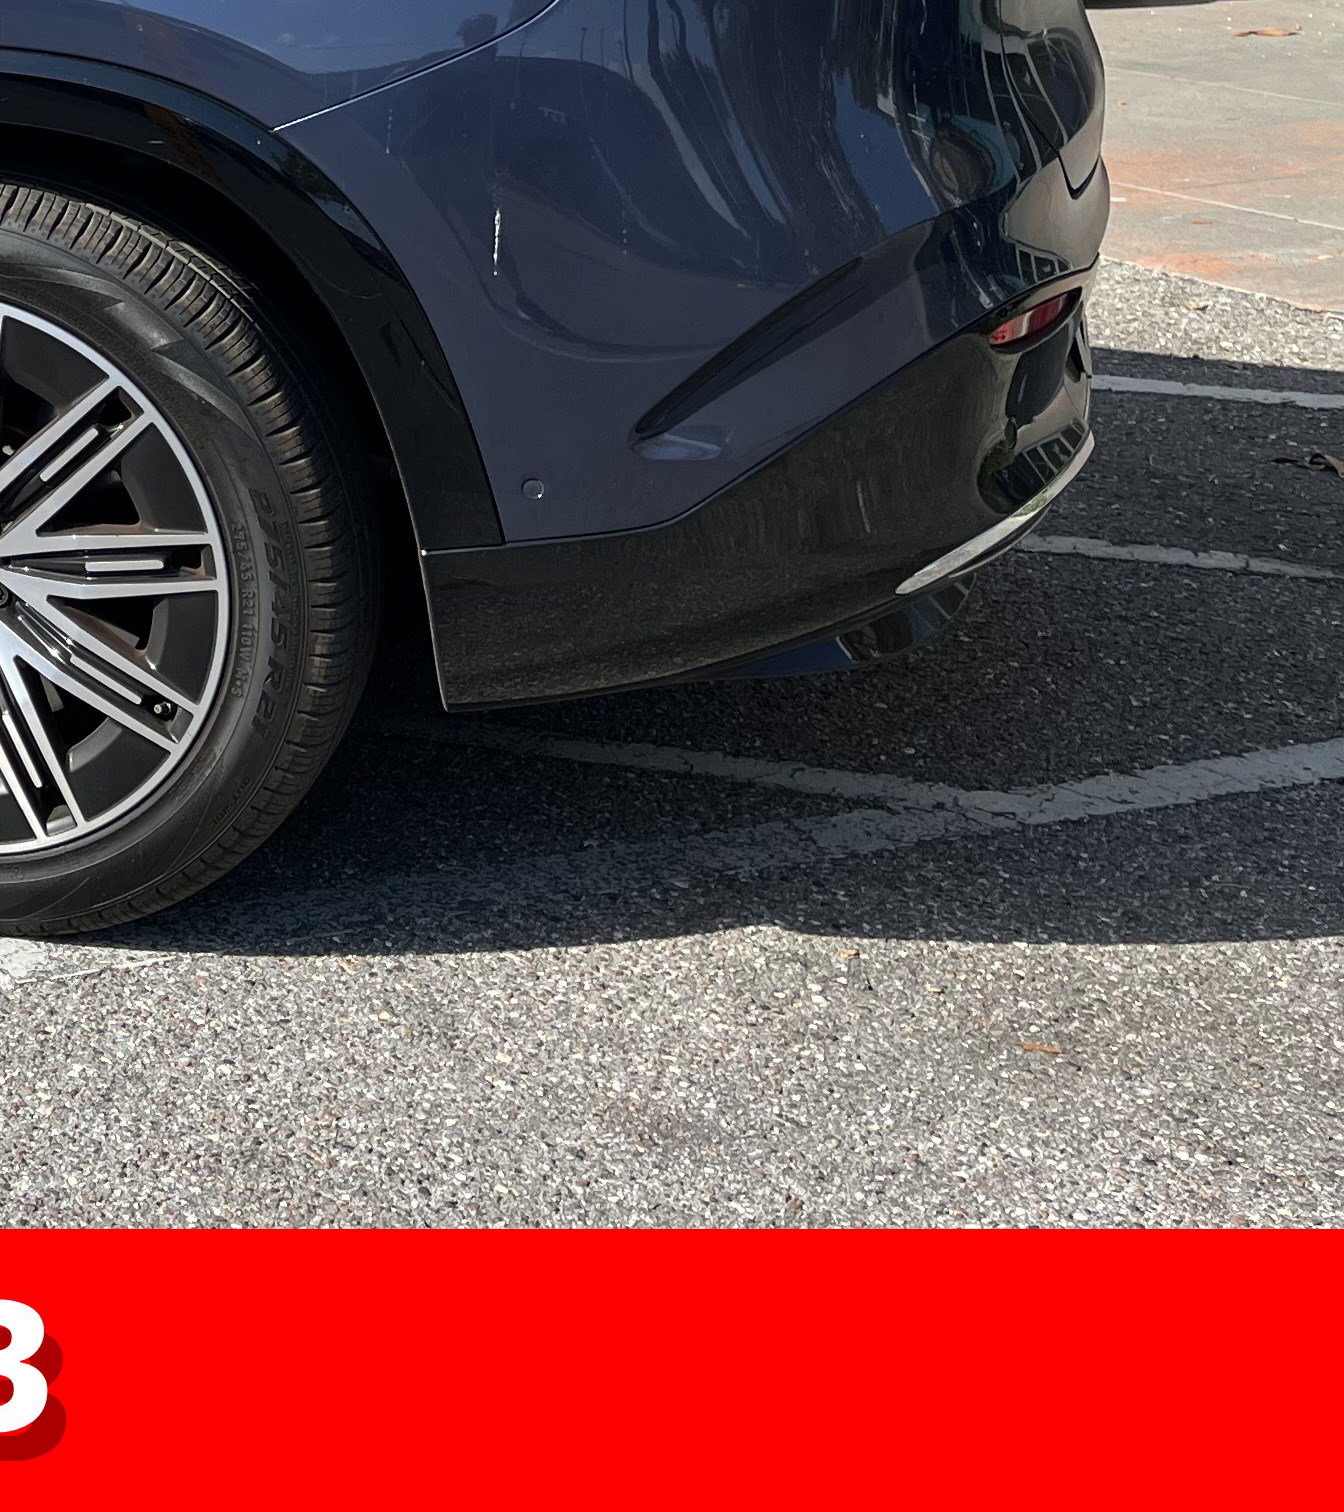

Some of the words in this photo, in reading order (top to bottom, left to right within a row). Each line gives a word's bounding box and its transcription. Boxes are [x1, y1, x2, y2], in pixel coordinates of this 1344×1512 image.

[229, 521, 253, 588] 275/45
[248, 486, 292, 652] 275/45
[238, 588, 256, 616] R21
[251, 656, 285, 740] R21
